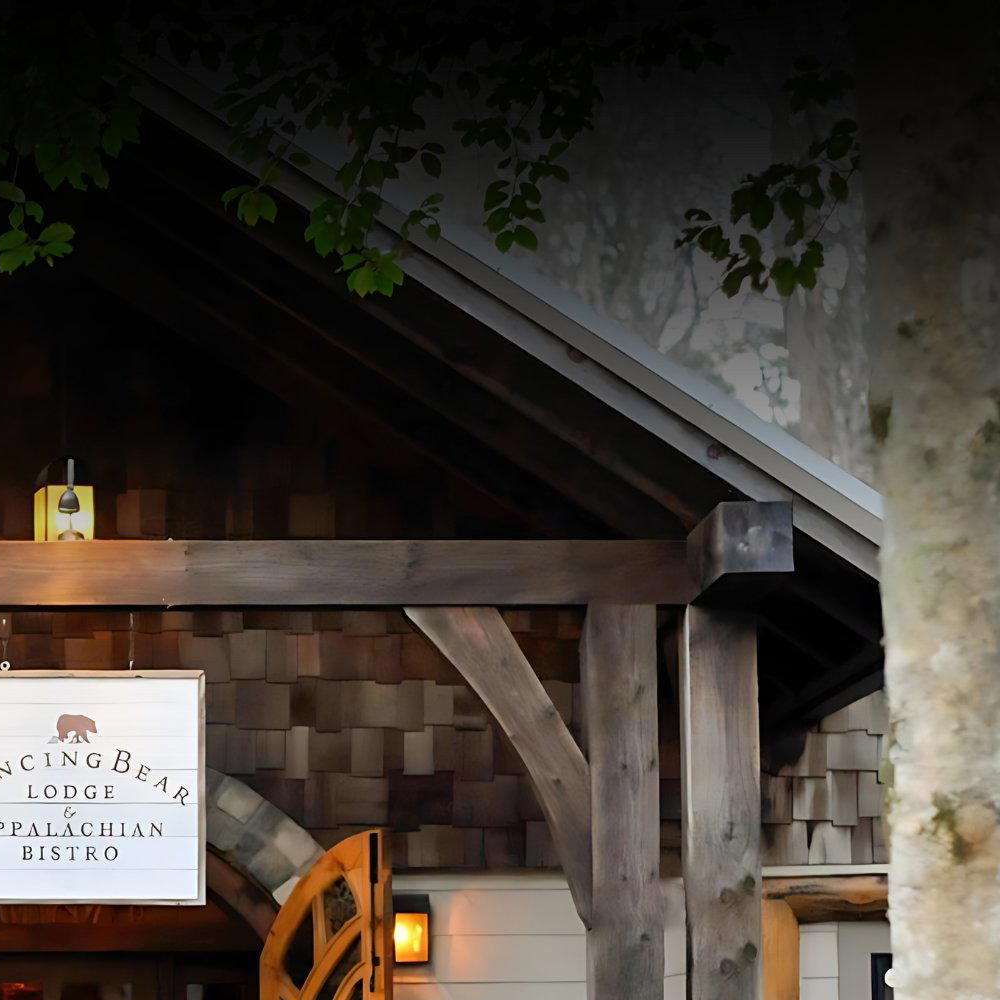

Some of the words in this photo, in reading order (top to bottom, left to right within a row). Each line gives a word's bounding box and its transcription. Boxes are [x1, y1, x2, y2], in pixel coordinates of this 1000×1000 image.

[111, 748, 190, 806] BEAR
[27, 784, 115, 800] LODGE
[63, 805, 77, 819] &
[22, 845, 119, 861] BISTRO
